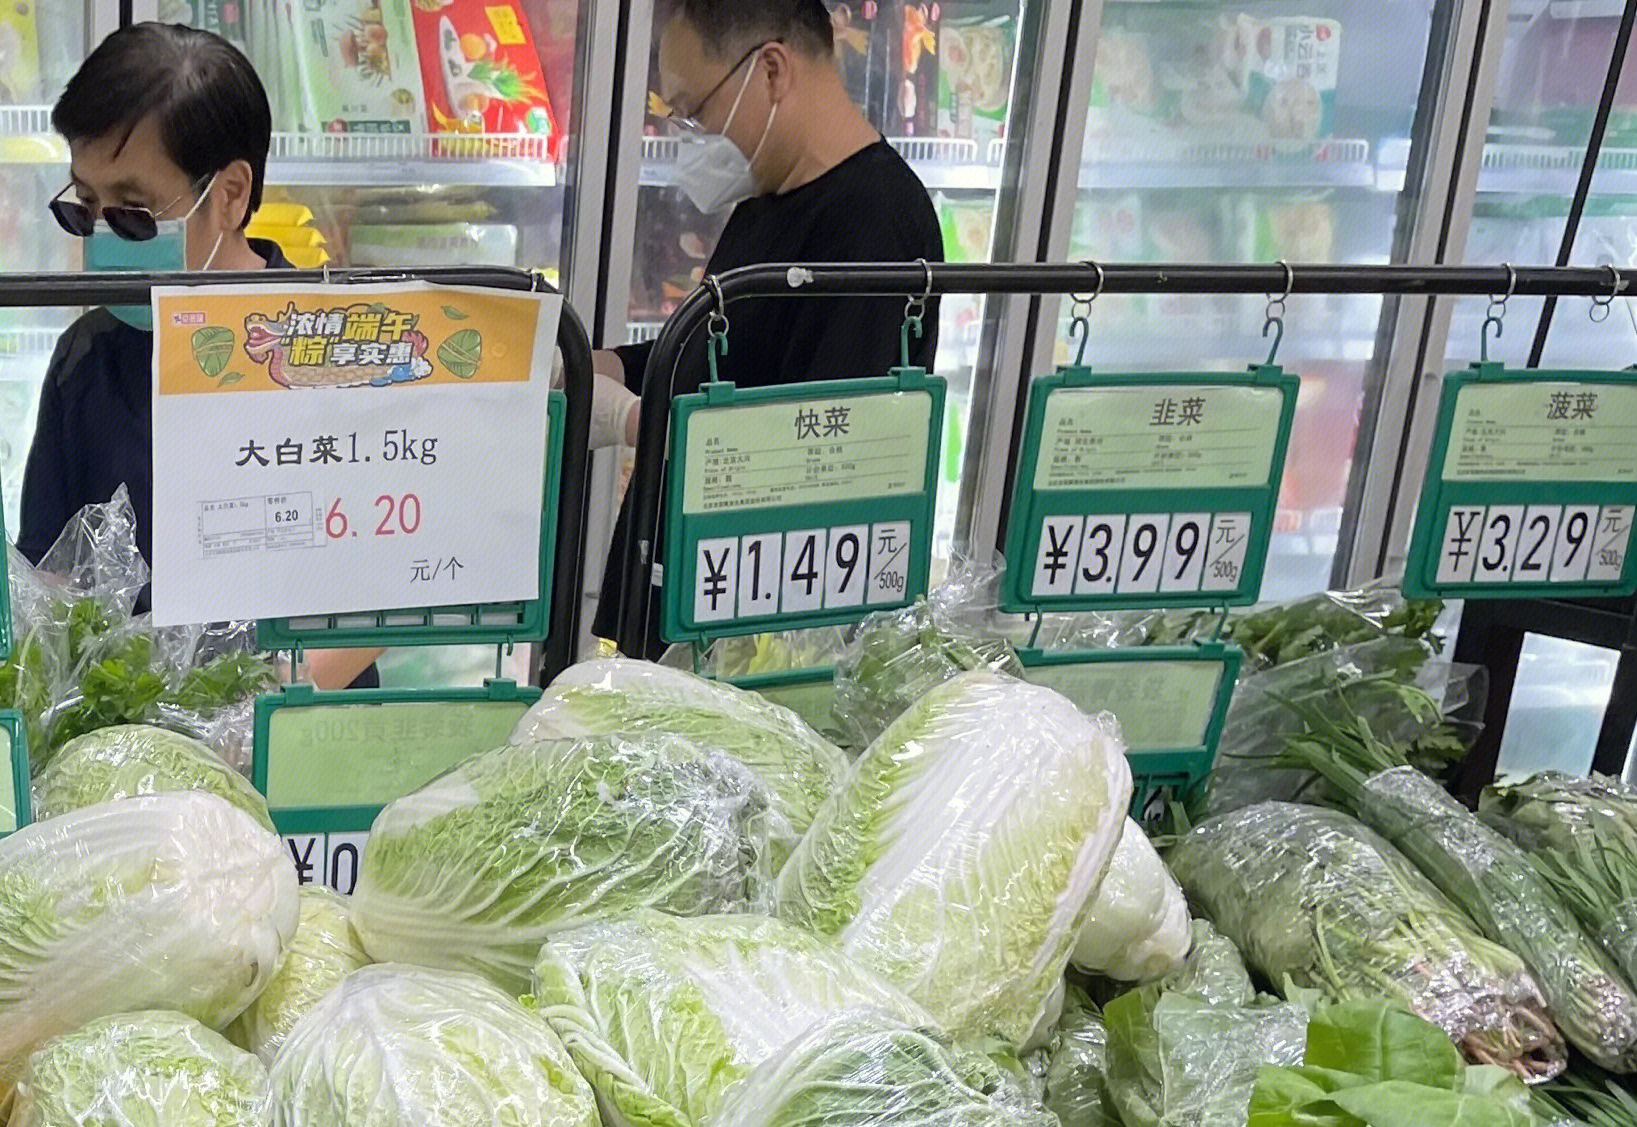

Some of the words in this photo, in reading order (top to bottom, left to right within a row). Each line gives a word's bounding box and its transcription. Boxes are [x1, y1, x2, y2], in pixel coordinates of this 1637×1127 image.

[1150, 397, 1205, 427] 韭菜
[1547, 392, 1598, 420] 菠菜
[794, 406, 851, 441] 快菜
[275, 510, 298, 522] 6.20
[325, 493, 421, 539] 6.20
[703, 533, 860, 611] ¥1.49
